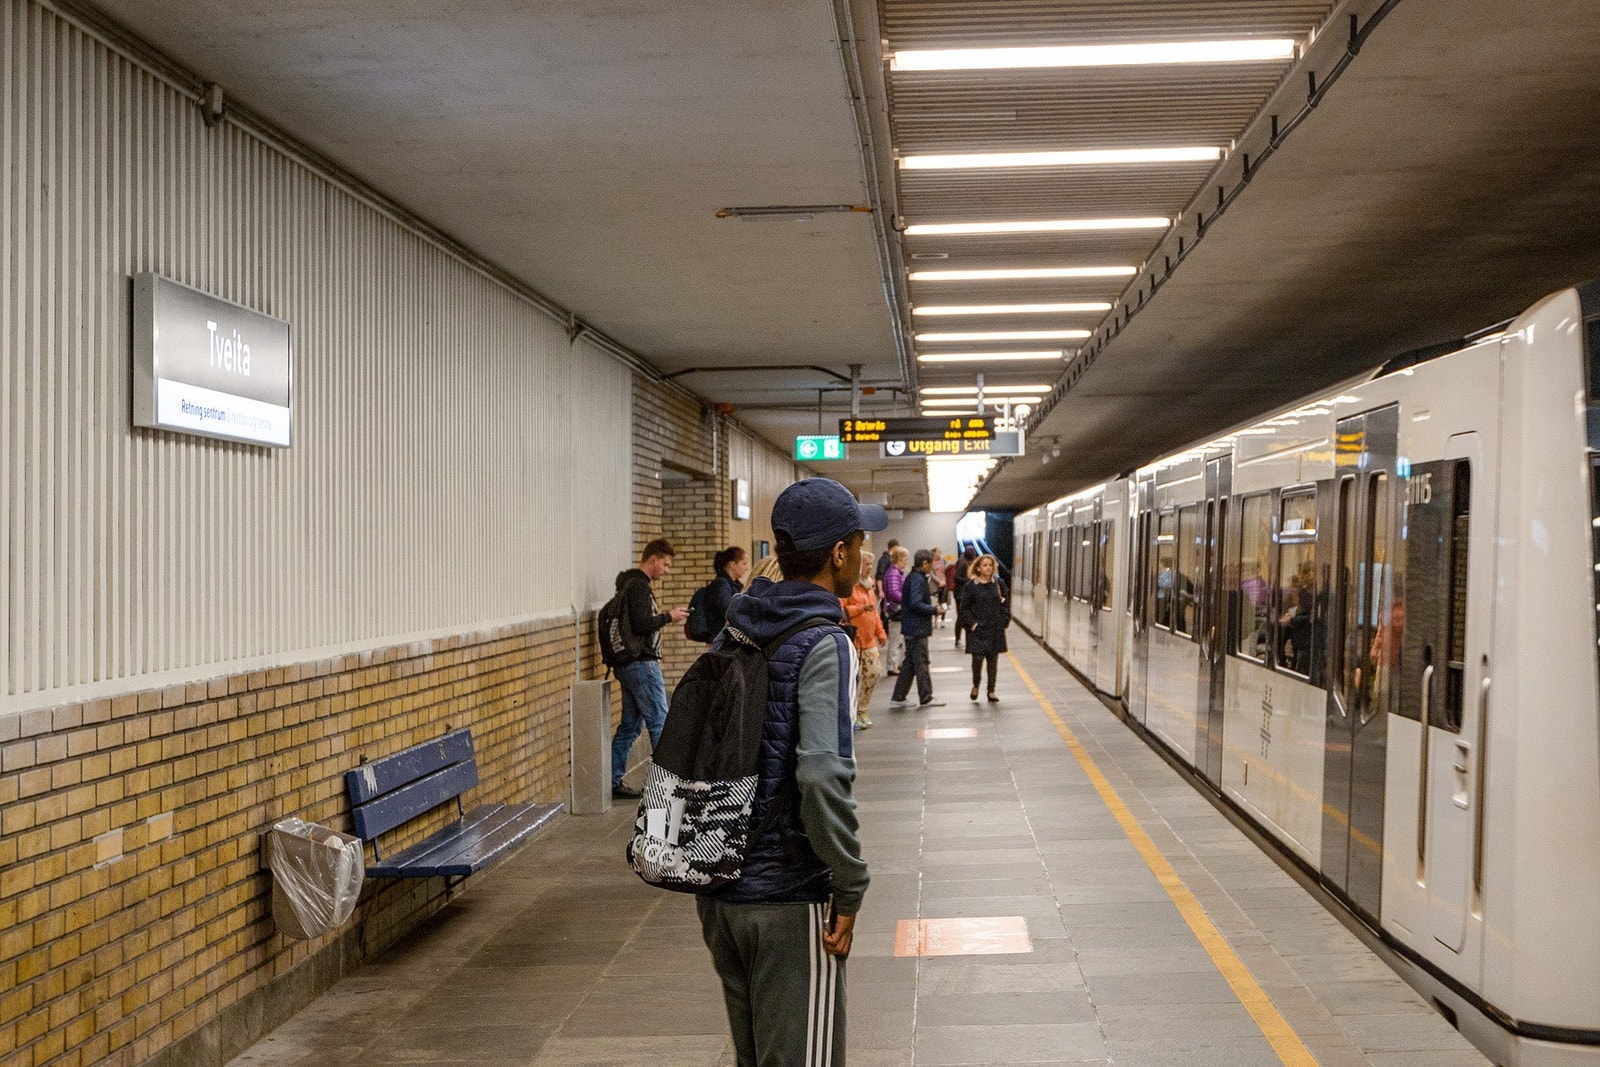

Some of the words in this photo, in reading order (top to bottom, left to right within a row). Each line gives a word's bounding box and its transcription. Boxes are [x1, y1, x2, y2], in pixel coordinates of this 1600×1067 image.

[206, 320, 251, 377] Tveita
[181, 398, 203, 421] Retning
[203, 405, 226, 421] sentrum
[844, 420, 852, 431] 2
[908, 440, 960, 455] Utgang
[963, 439, 990, 451] Exit
